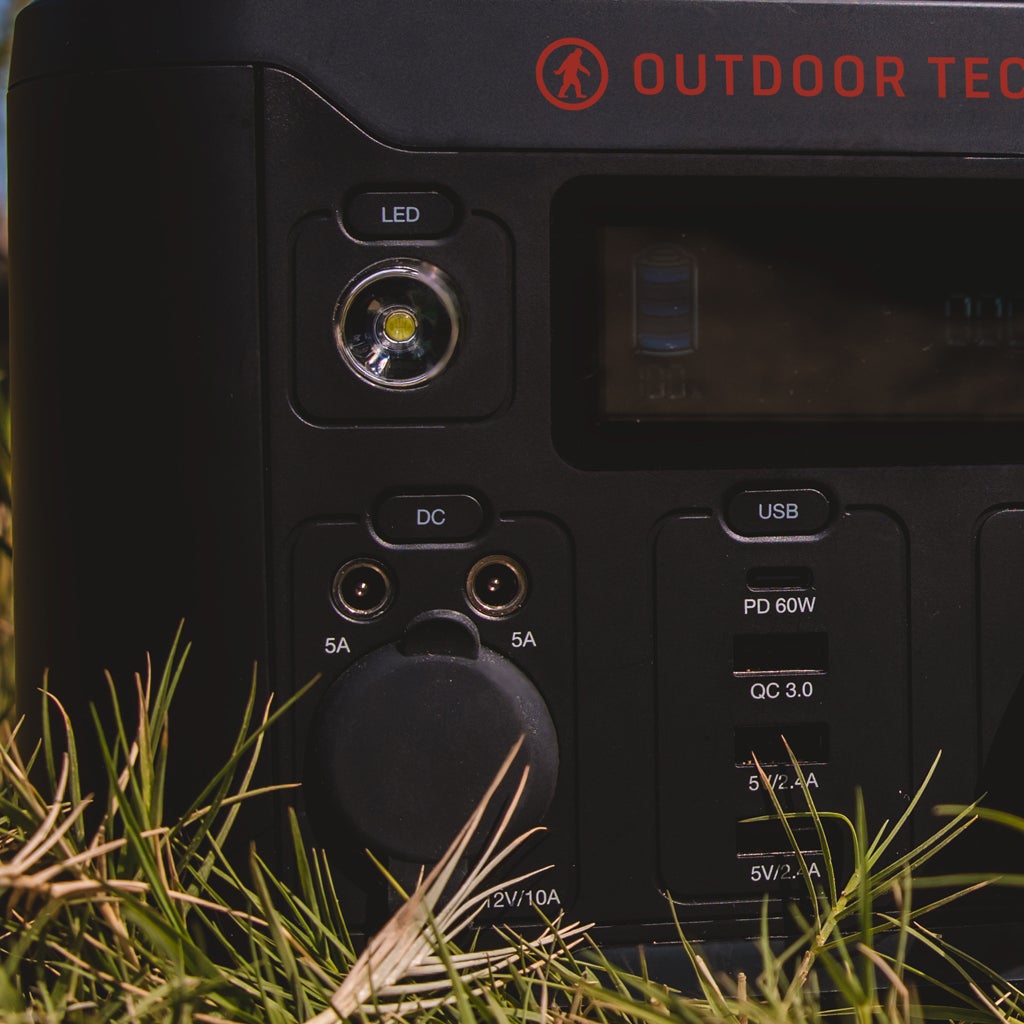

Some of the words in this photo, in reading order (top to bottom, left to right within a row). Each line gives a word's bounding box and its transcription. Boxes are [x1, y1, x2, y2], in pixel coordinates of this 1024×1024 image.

[632, 52, 905, 98] OUTDOOR
[381, 206, 420, 223] LED
[416, 508, 446, 526] DC
[758, 503, 799, 520] USB
[744, 598, 771, 615] PD
[775, 596, 816, 614] 60W
[324, 636, 351, 654] 5A
[511, 630, 537, 648] 5A
[750, 682, 780, 700] QC
[785, 681, 813, 698] 3.0
